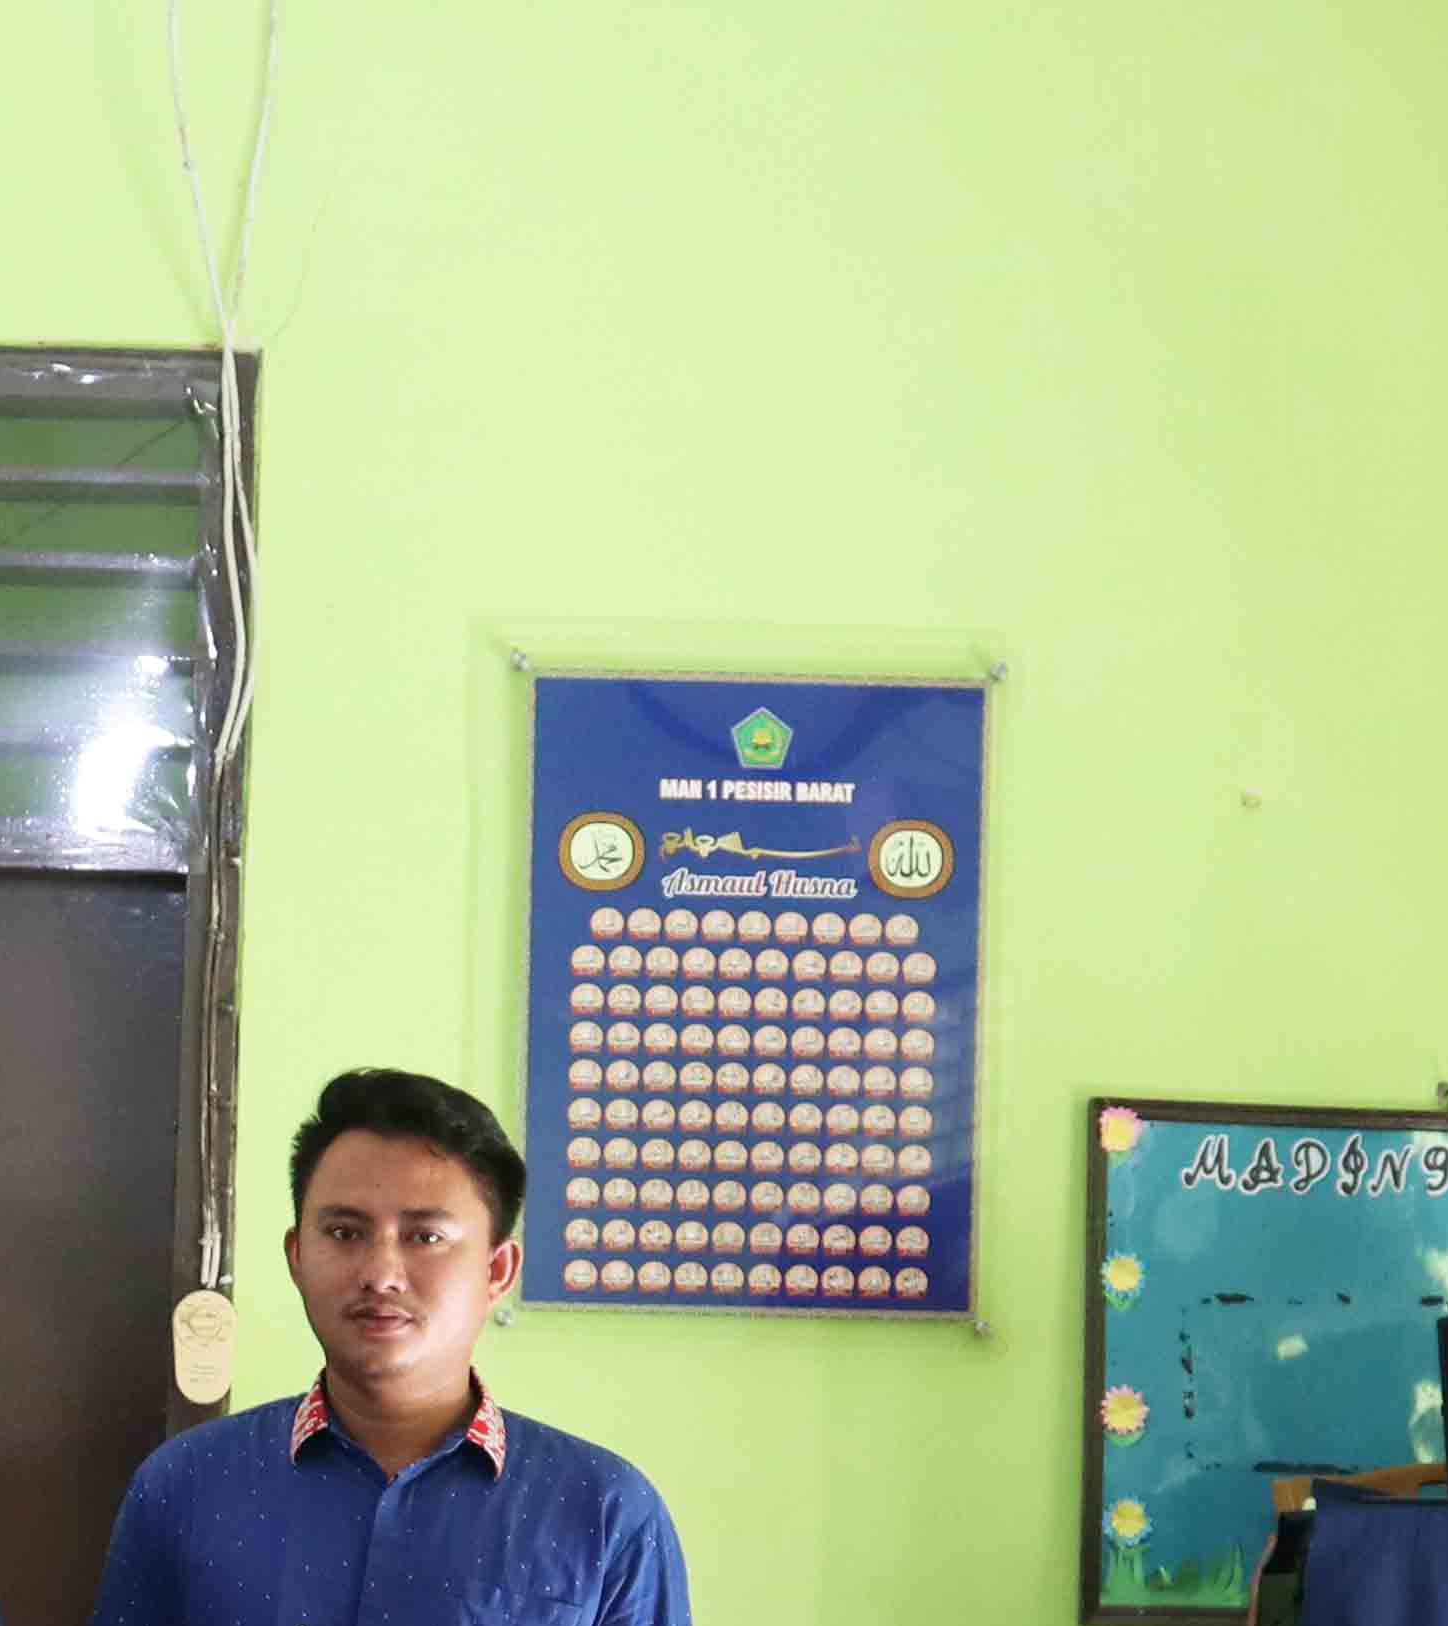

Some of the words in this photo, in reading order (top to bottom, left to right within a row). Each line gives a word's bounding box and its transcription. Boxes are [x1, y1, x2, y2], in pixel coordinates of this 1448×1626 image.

[659, 778, 702, 799] MAN
[706, 780, 718, 799] 1
[722, 781, 792, 801] PESISIR
[796, 783, 855, 803] BARAT
[662, 867, 767, 898] Asmaul
[769, 870, 858, 898] Husna
